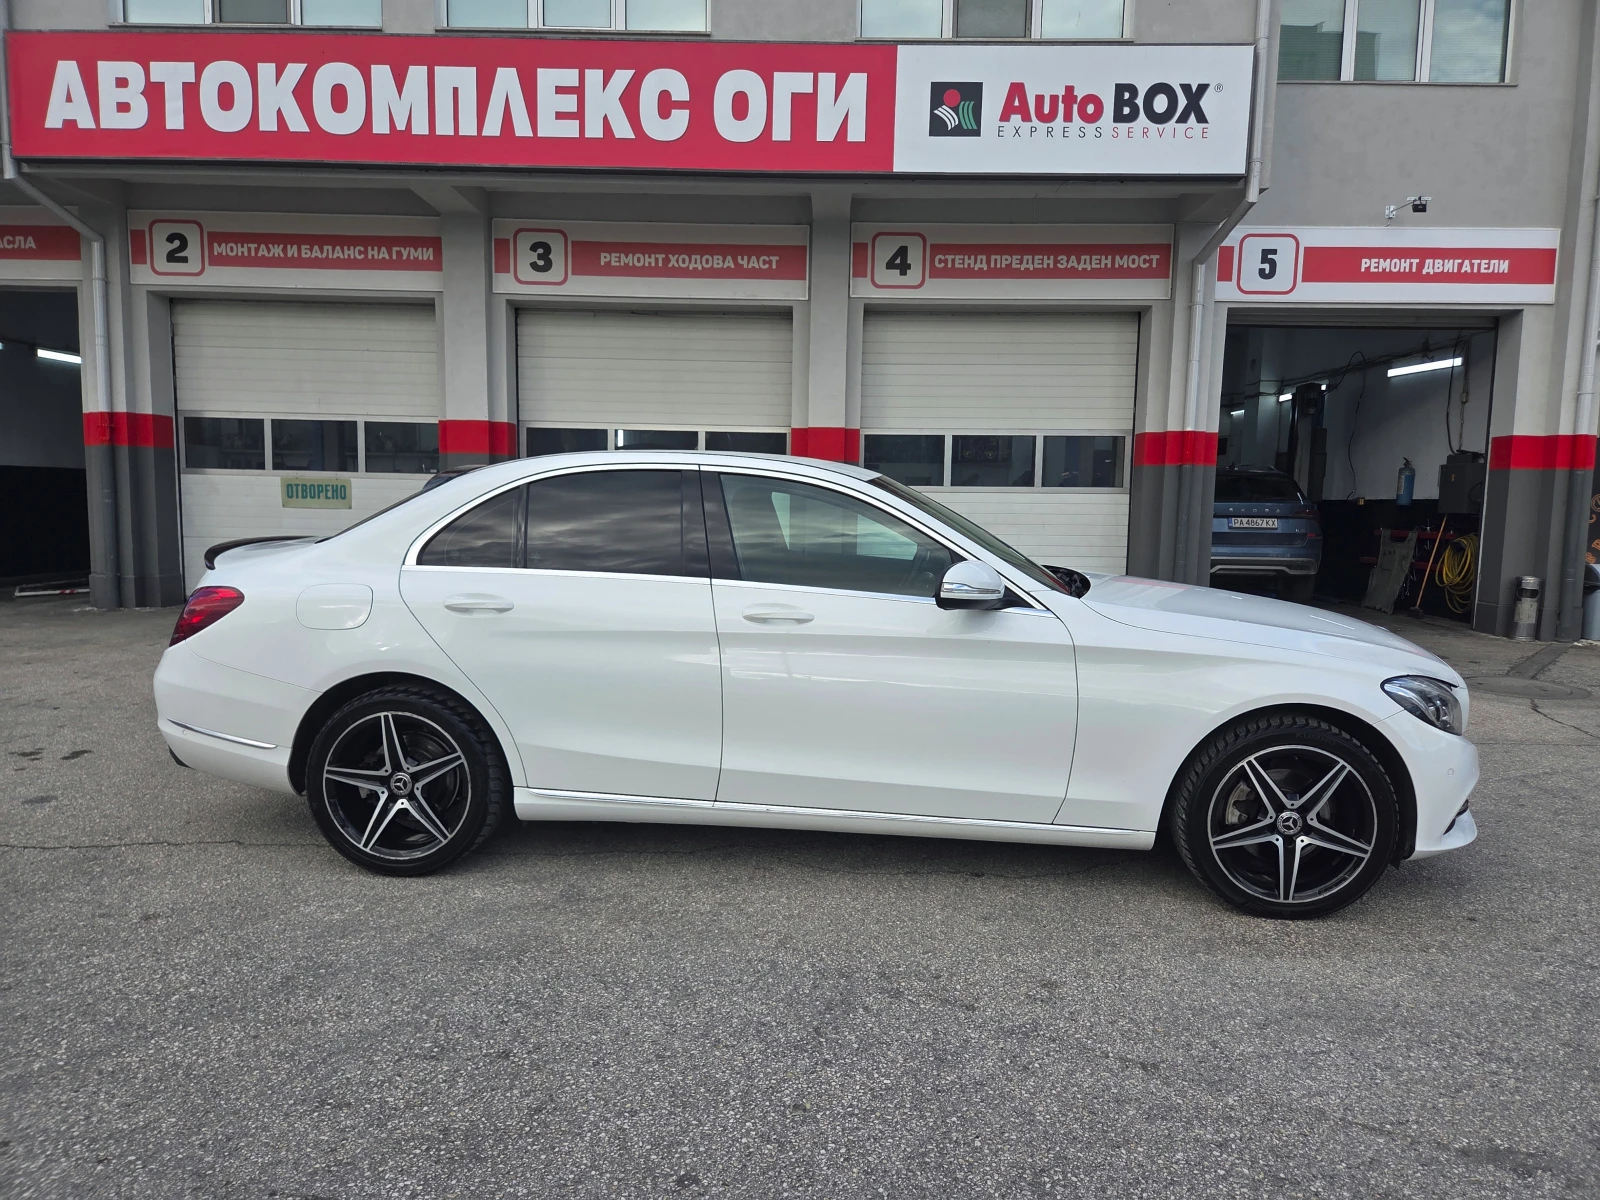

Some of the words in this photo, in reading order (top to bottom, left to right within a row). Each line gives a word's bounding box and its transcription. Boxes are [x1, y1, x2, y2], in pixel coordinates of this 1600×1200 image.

[44, 60, 690, 142] АВТОКОМПЛЕКС
[713, 69, 868, 143] ОГИ
[999, 82, 1104, 124] Auto
[1112, 82, 1210, 125] BOX
[997, 126, 1103, 138] EXPRESS
[1111, 127, 1209, 138] SERVICE
[165, 232, 188, 263] 2
[213, 242, 284, 257] МОНТАЖ
[287, 244, 298, 258] И
[301, 244, 365, 260] БАЛАНС
[368, 246, 388, 260] НА
[392, 247, 434, 261] ГУМИ
[529, 240, 553, 273] 3
[600, 252, 665, 267] РЕМОНТ
[668, 253, 735, 270] ХОДОВА
[737, 255, 780, 269] ЧАСТ
[885, 245, 912, 277] 4
[934, 254, 988, 271] СТЕНД
[990, 254, 1054, 271] ПРЕДЕН
[1056, 254, 1112, 271] ЗАДЕН
[1114, 254, 1160, 268] МОСТ
[1258, 248, 1278, 280] 5
[1360, 258, 1419, 273] РЕМОНТ
[1422, 259, 1509, 275] ДВИГАТЕЛИ
[286, 483, 347, 500] ОТВОРЕНО
[1233, 518, 1244, 526] PA
